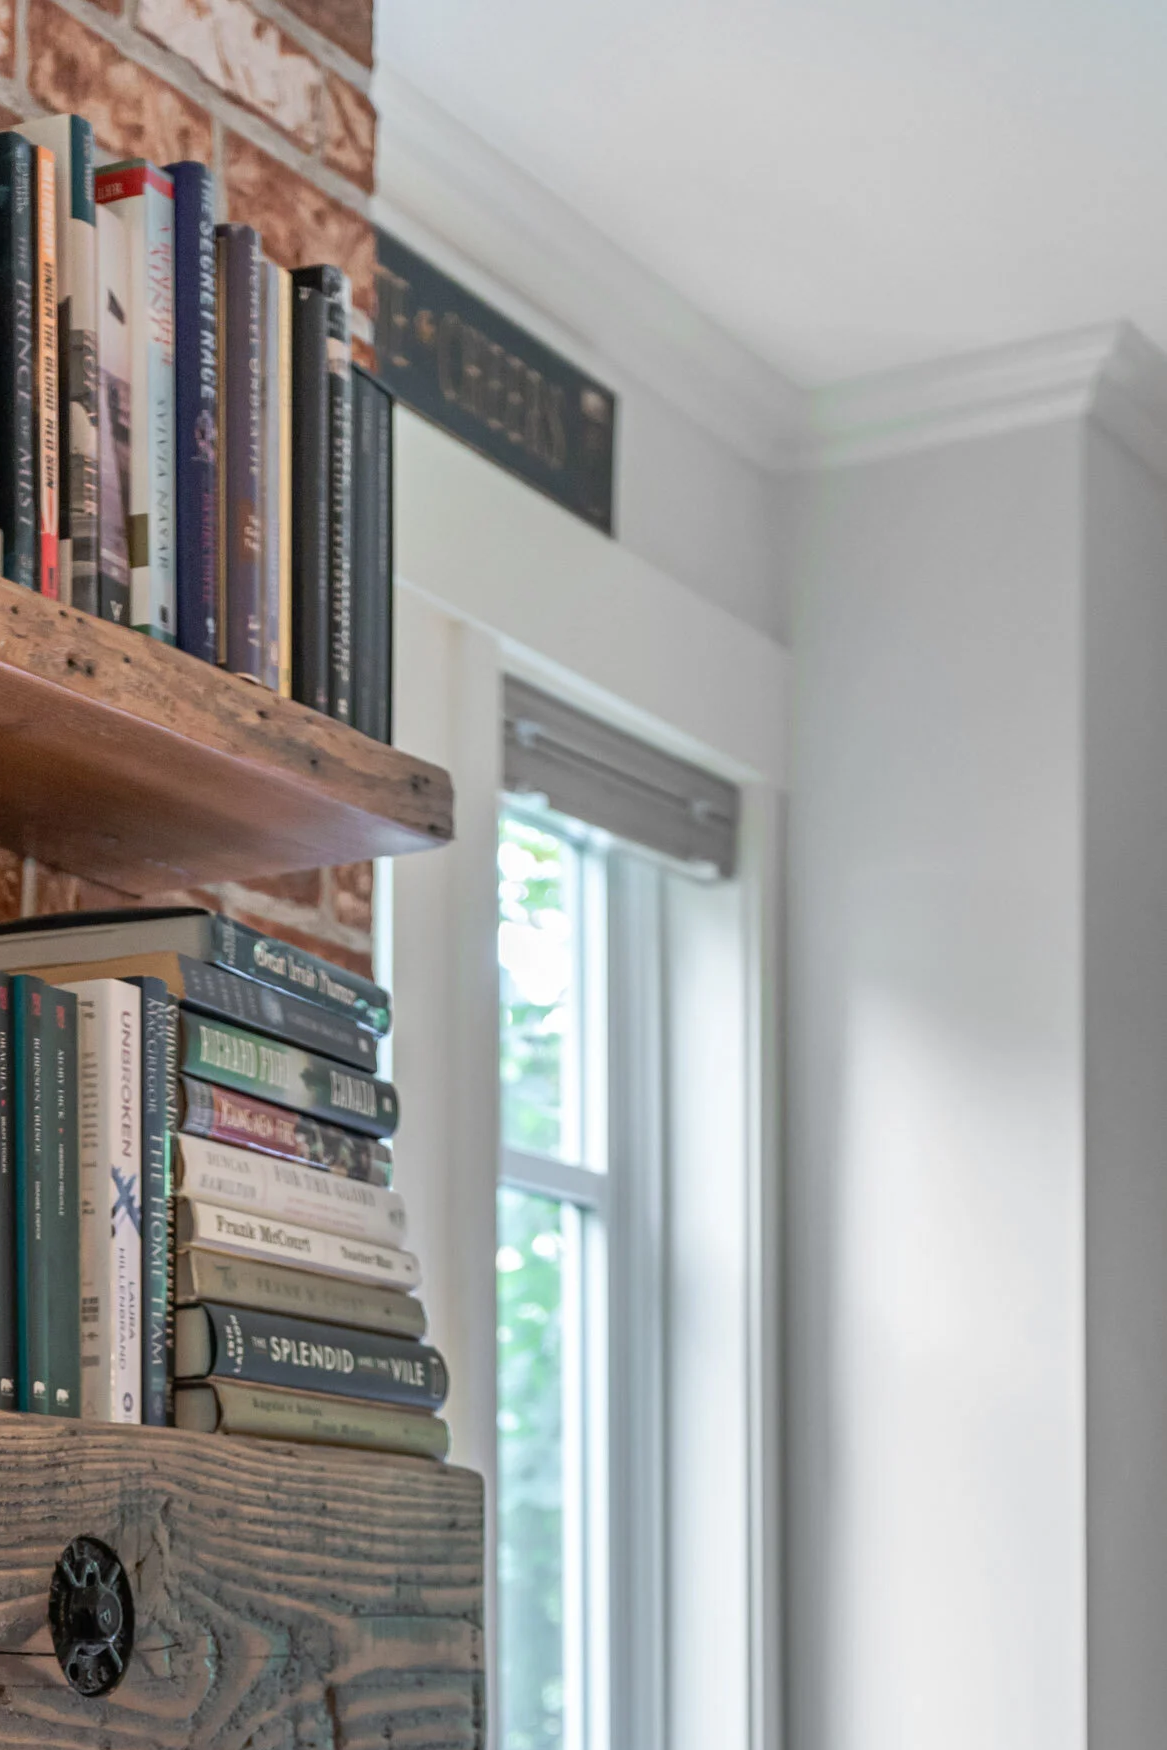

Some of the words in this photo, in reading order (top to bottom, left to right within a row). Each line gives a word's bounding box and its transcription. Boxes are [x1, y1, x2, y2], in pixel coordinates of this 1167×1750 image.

[200, 219, 216, 322] SECRET
[200, 330, 216, 398] RAGE
[120, 1009, 133, 1158] UNBROKEN
[216, 1215, 256, 1240] Frank
[259, 1224, 312, 1253] McCourt
[118, 1247, 127, 1371] HILLENBRAND
[251, 1336, 267, 1349] THE
[269, 1335, 355, 1374] SPLENDID
[390, 1357, 425, 1386] VILE
